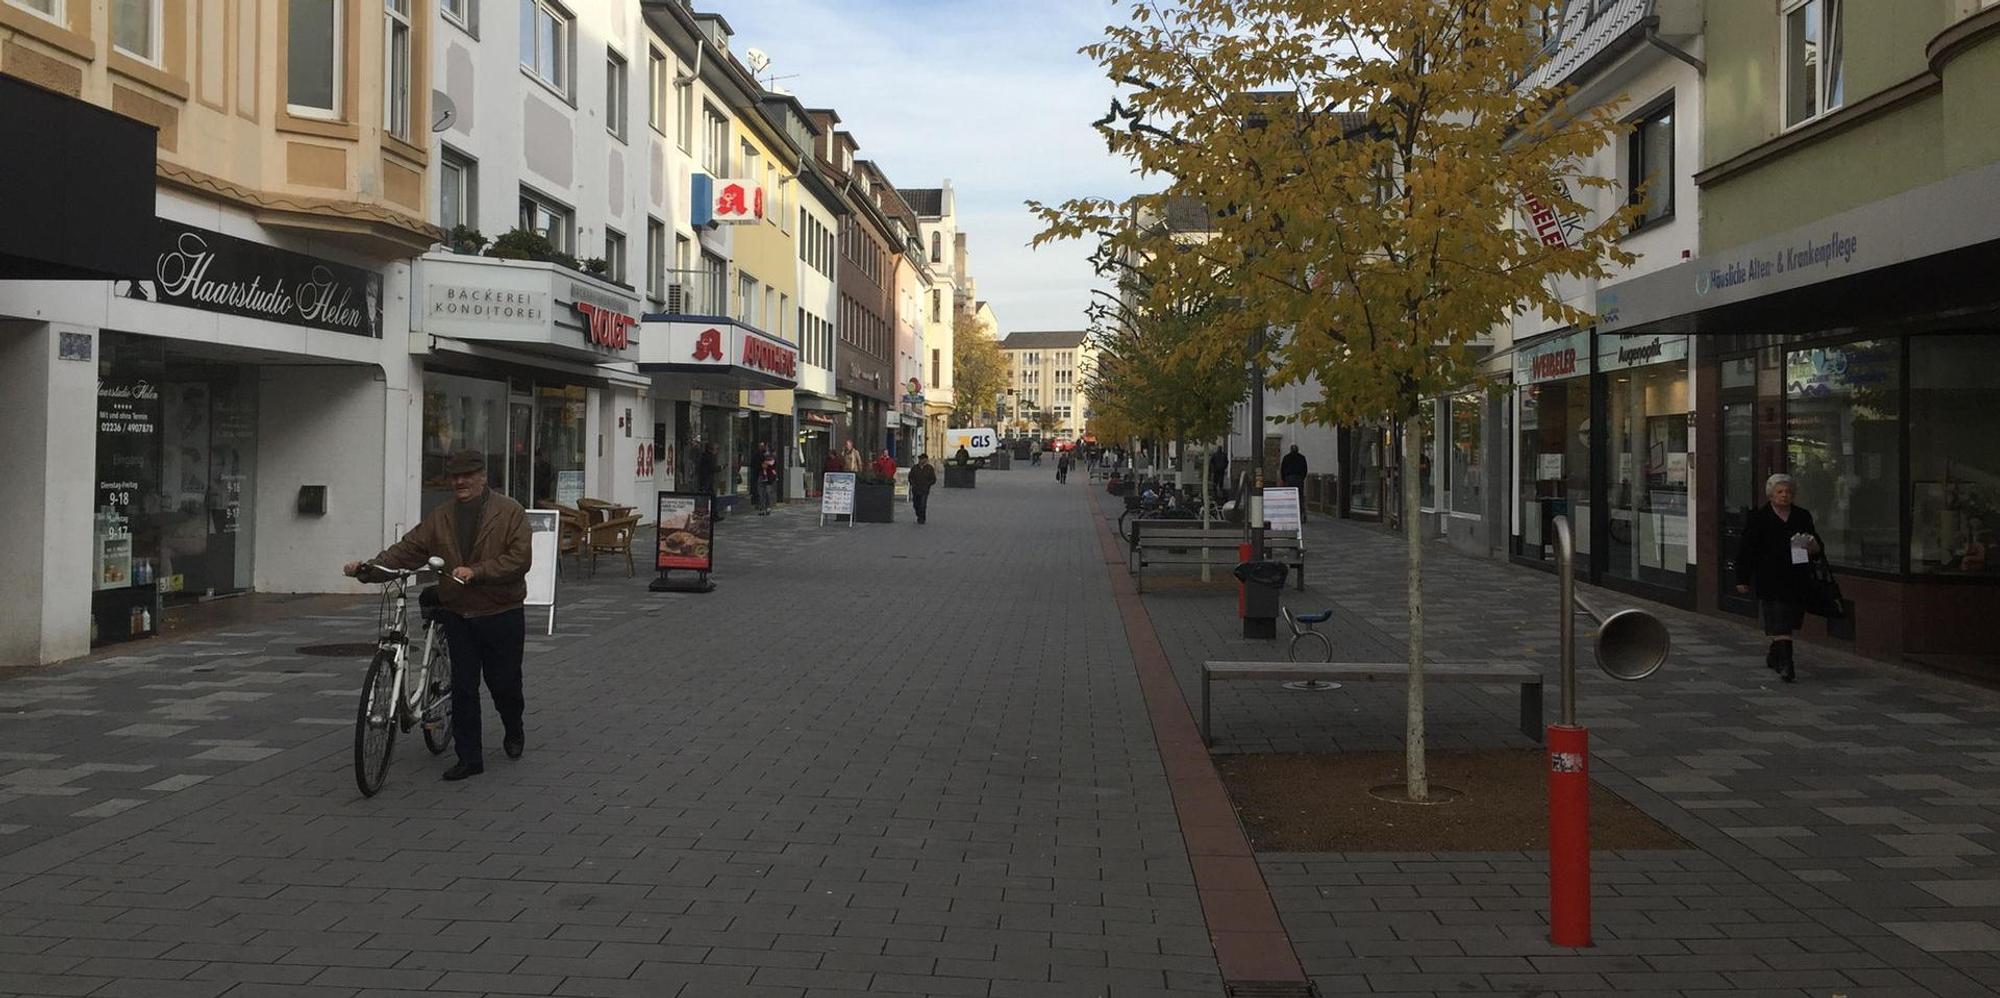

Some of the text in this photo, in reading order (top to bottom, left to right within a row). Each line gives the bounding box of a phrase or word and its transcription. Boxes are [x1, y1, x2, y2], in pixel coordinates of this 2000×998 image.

[1777, 250, 1784, 274] &
[1787, 232, 1857, 271] Krankenpflege
[156, 232, 362, 328] Haarstudio Helen
[435, 302, 542, 320] KONDITOREI
[577, 301, 636, 350] VOIGT
[742, 334, 797, 379] APOTHEKE
[1618, 336, 1662, 366] Augenoptik
[971, 435, 990, 448] GLS
[109, 491, 130, 506] 9-18
